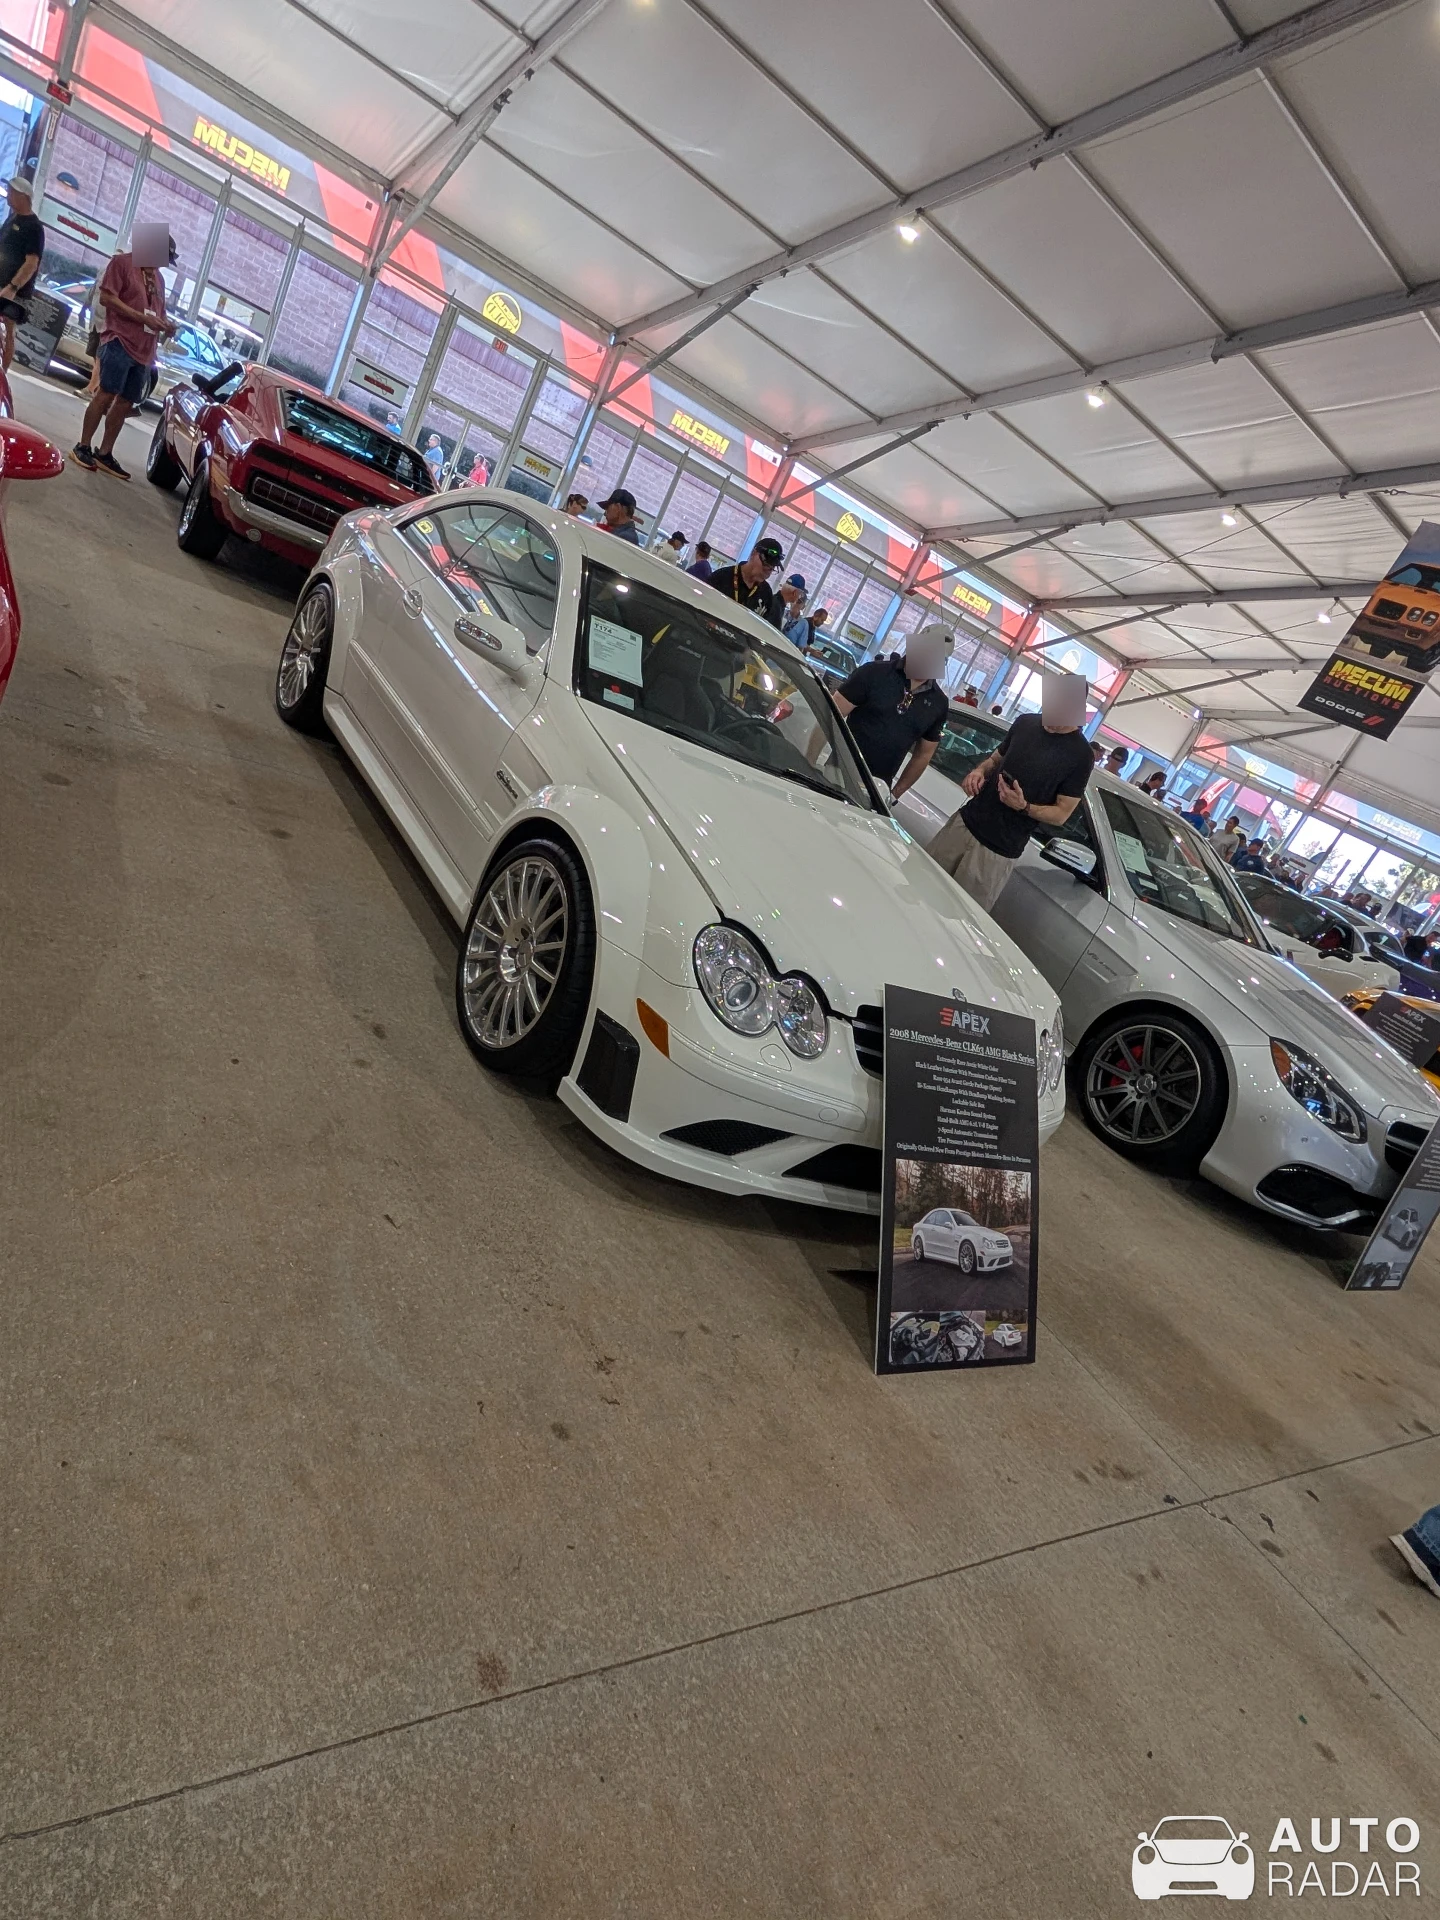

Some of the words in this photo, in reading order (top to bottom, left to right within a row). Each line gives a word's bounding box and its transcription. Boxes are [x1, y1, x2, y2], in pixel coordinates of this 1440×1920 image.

[1323, 675, 1403, 710] AUCTIONS
[1328, 660, 1413, 702] MECUM
[1314, 695, 1366, 719] DODGE
[951, 1010, 991, 1035] APEX
[1404, 1008, 1427, 1023] APEX
[889, 1028, 910, 1039] 2008
[911, 1030, 962, 1050] Mercedes-Benz
[962, 1041, 985, 1055] CLK63
[985, 1045, 1001, 1057] AMG
[1001, 1049, 1018, 1061] Black
[1018, 1053, 1036, 1065] Series
